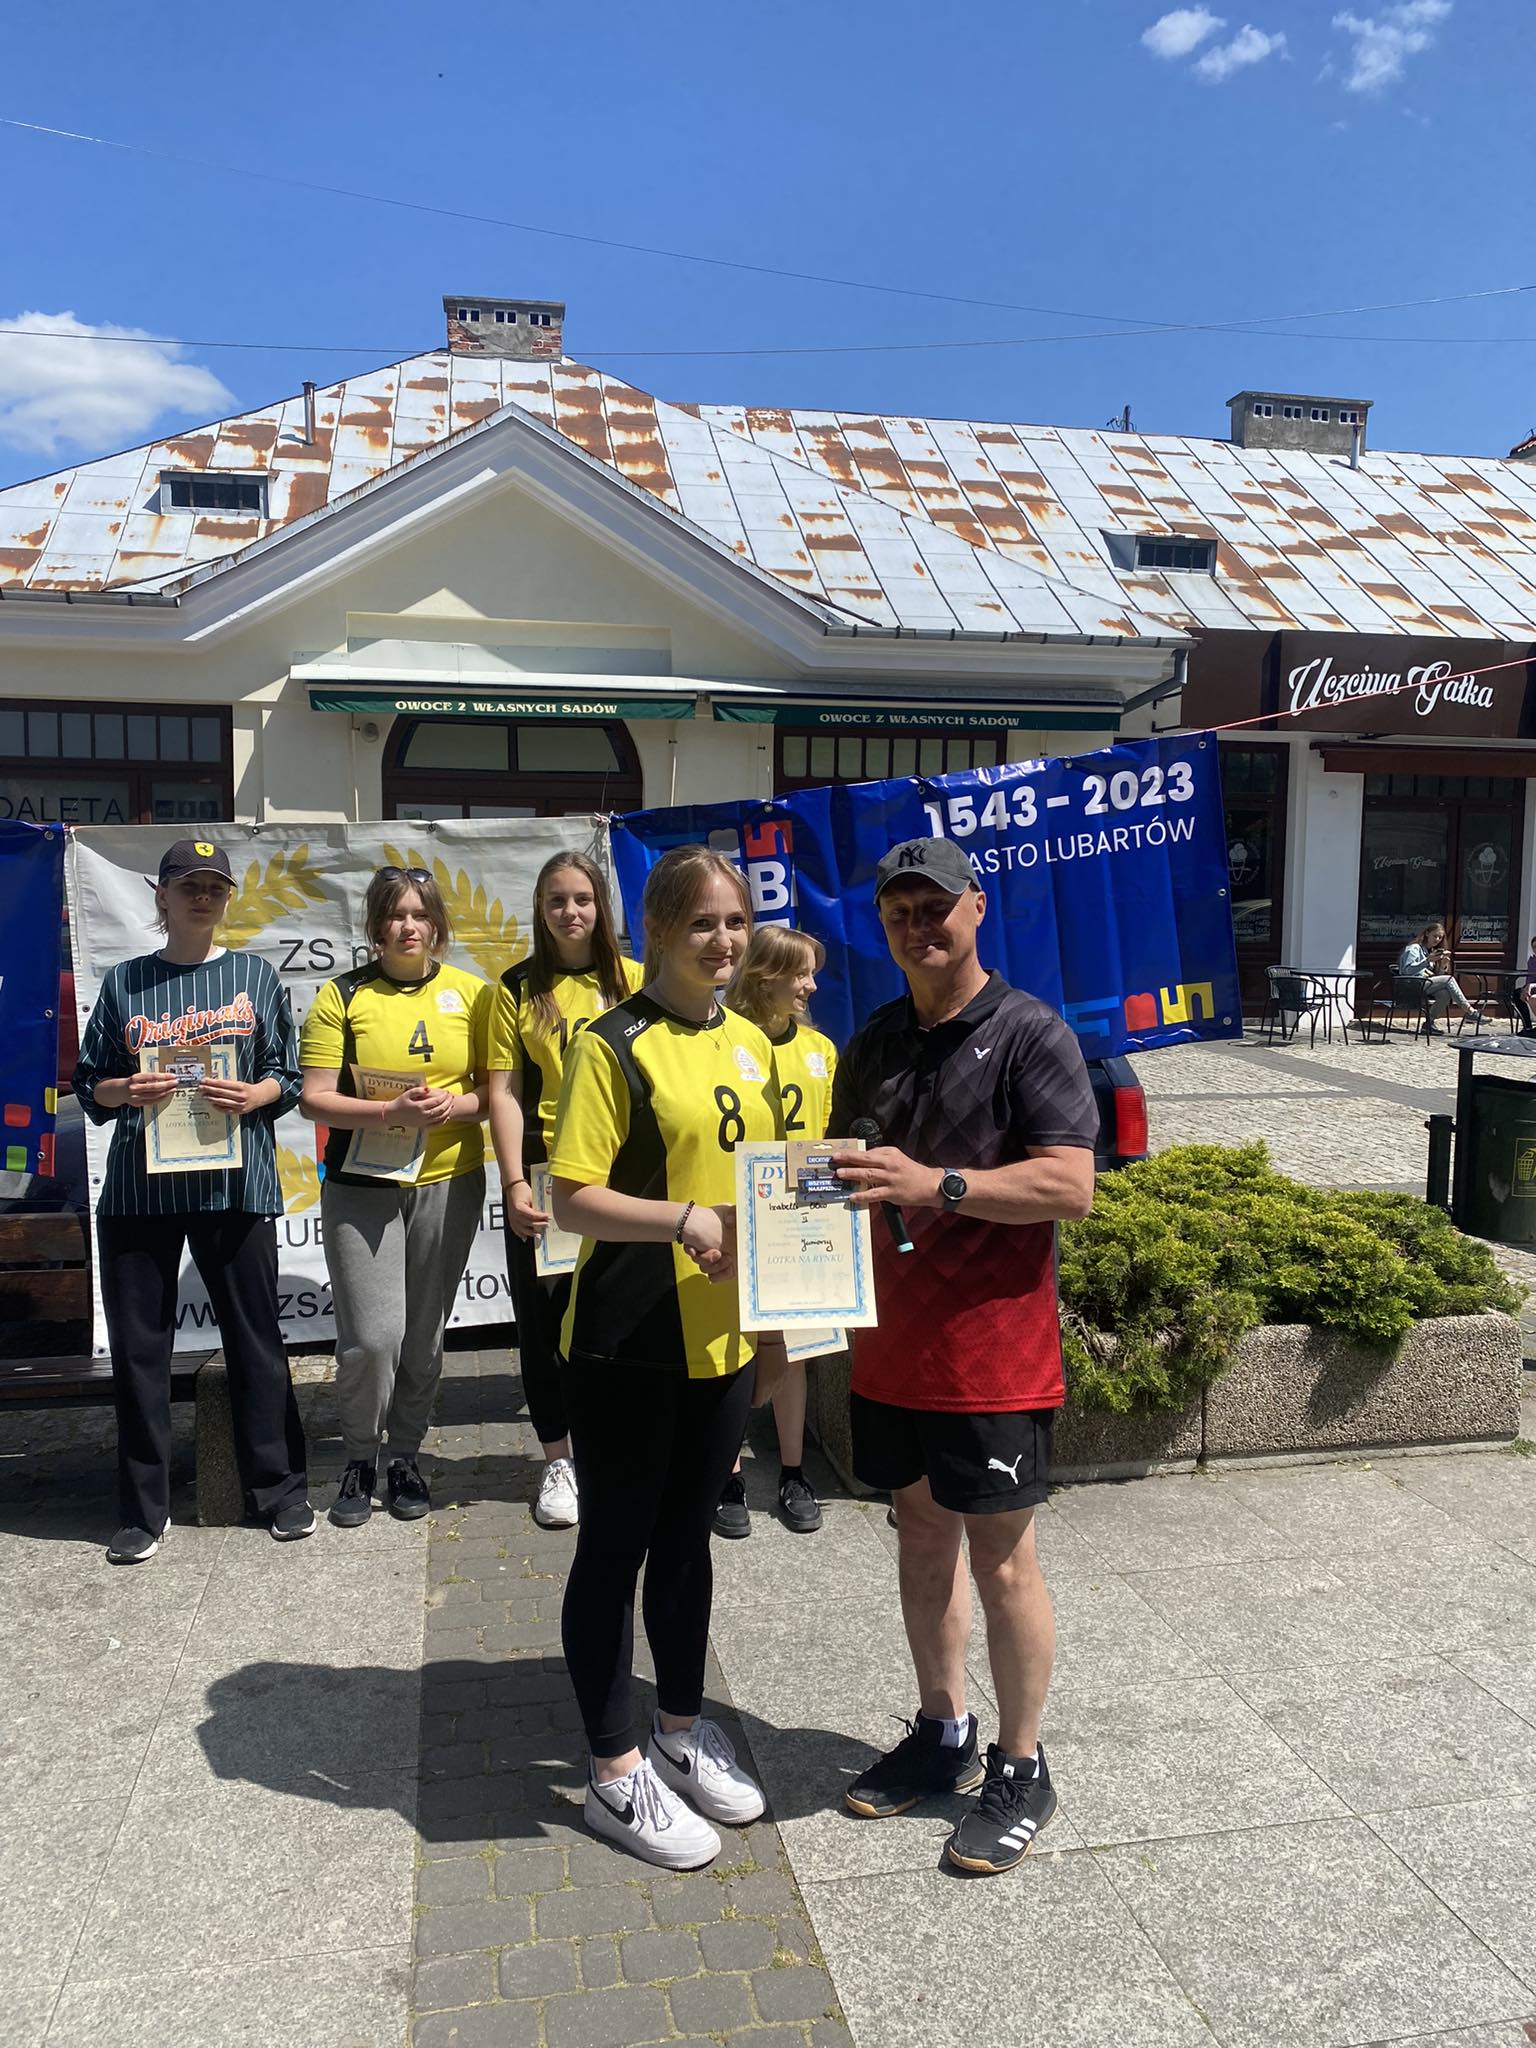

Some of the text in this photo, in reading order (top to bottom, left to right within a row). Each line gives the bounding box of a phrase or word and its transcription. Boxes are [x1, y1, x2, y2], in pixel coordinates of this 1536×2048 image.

[395, 701, 452, 711] OWOCE
[473, 702, 556, 713] WŁASNYCH
[561, 703, 617, 714] SADÓW
[1288, 657, 1401, 716] Uczciwa
[819, 713, 871, 723] OWOCE
[889, 715, 964, 725] WŁASNYCH
[969, 715, 1020, 726] SADÓW
[923, 785, 1038, 838] 1543
[1082, 761, 1195, 816] 2023
[969, 843, 1038, 875] ASTO
[1045, 815, 1196, 863] LUBARTÓW
[279, 938, 335, 972] ZS
[125, 992, 256, 1055] Originals
[408, 1019, 434, 1063] 4
[714, 1085, 746, 1151] 8
[781, 1083, 805, 1131] 2
